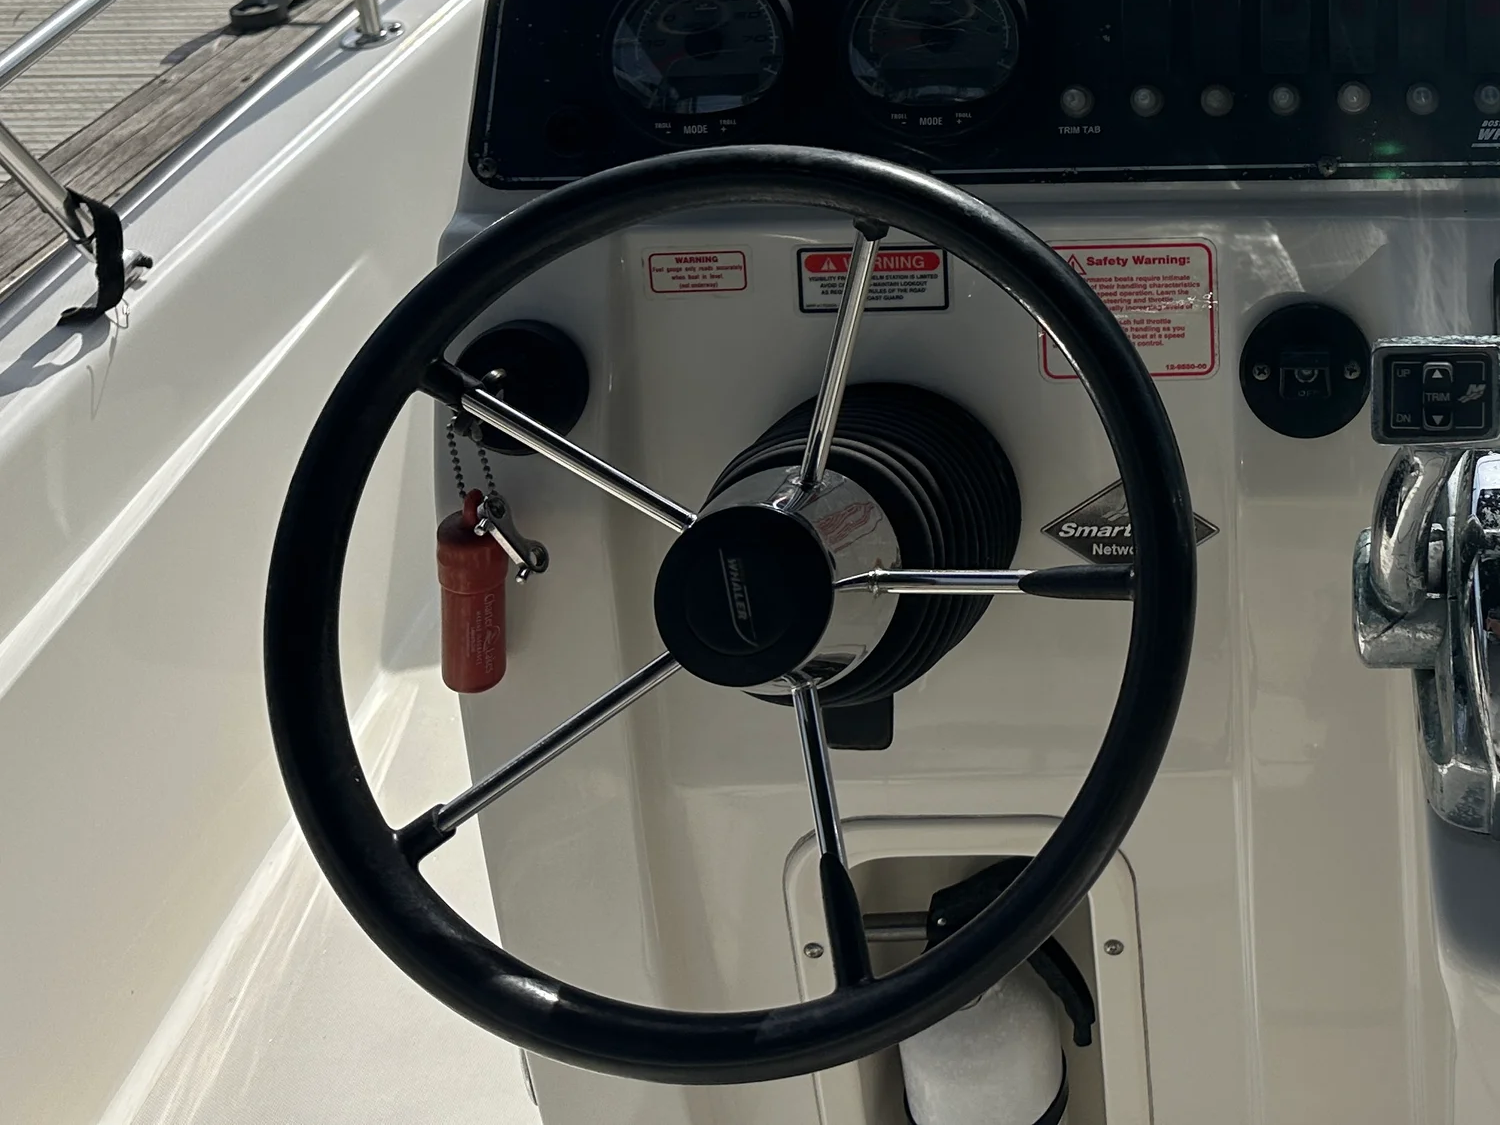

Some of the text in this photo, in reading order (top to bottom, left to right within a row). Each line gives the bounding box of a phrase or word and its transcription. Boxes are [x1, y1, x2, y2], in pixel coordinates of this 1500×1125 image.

[919, 116, 943, 126] MODE
[683, 125, 708, 134] MODE
[1058, 125, 1101, 134] TRIM TAB
[675, 255, 719, 263] WARNING
[1086, 255, 1191, 267] Safety Warning:
[1136, 275, 1160, 283] require
[1117, 282, 1148, 290] handling
[1149, 281, 1201, 289] characteristics
[1097, 290, 1118, 298] speed
[1119, 289, 1154, 297] operation.
[1103, 297, 1131, 305] steering
[1172, 325, 1186, 333] you
[1164, 333, 1186, 341] speed
[1397, 369, 1412, 378] UP
[1426, 392, 1450, 402] TRIM
[1396, 413, 1412, 422] DN
[1059, 523, 1132, 537] Smart
